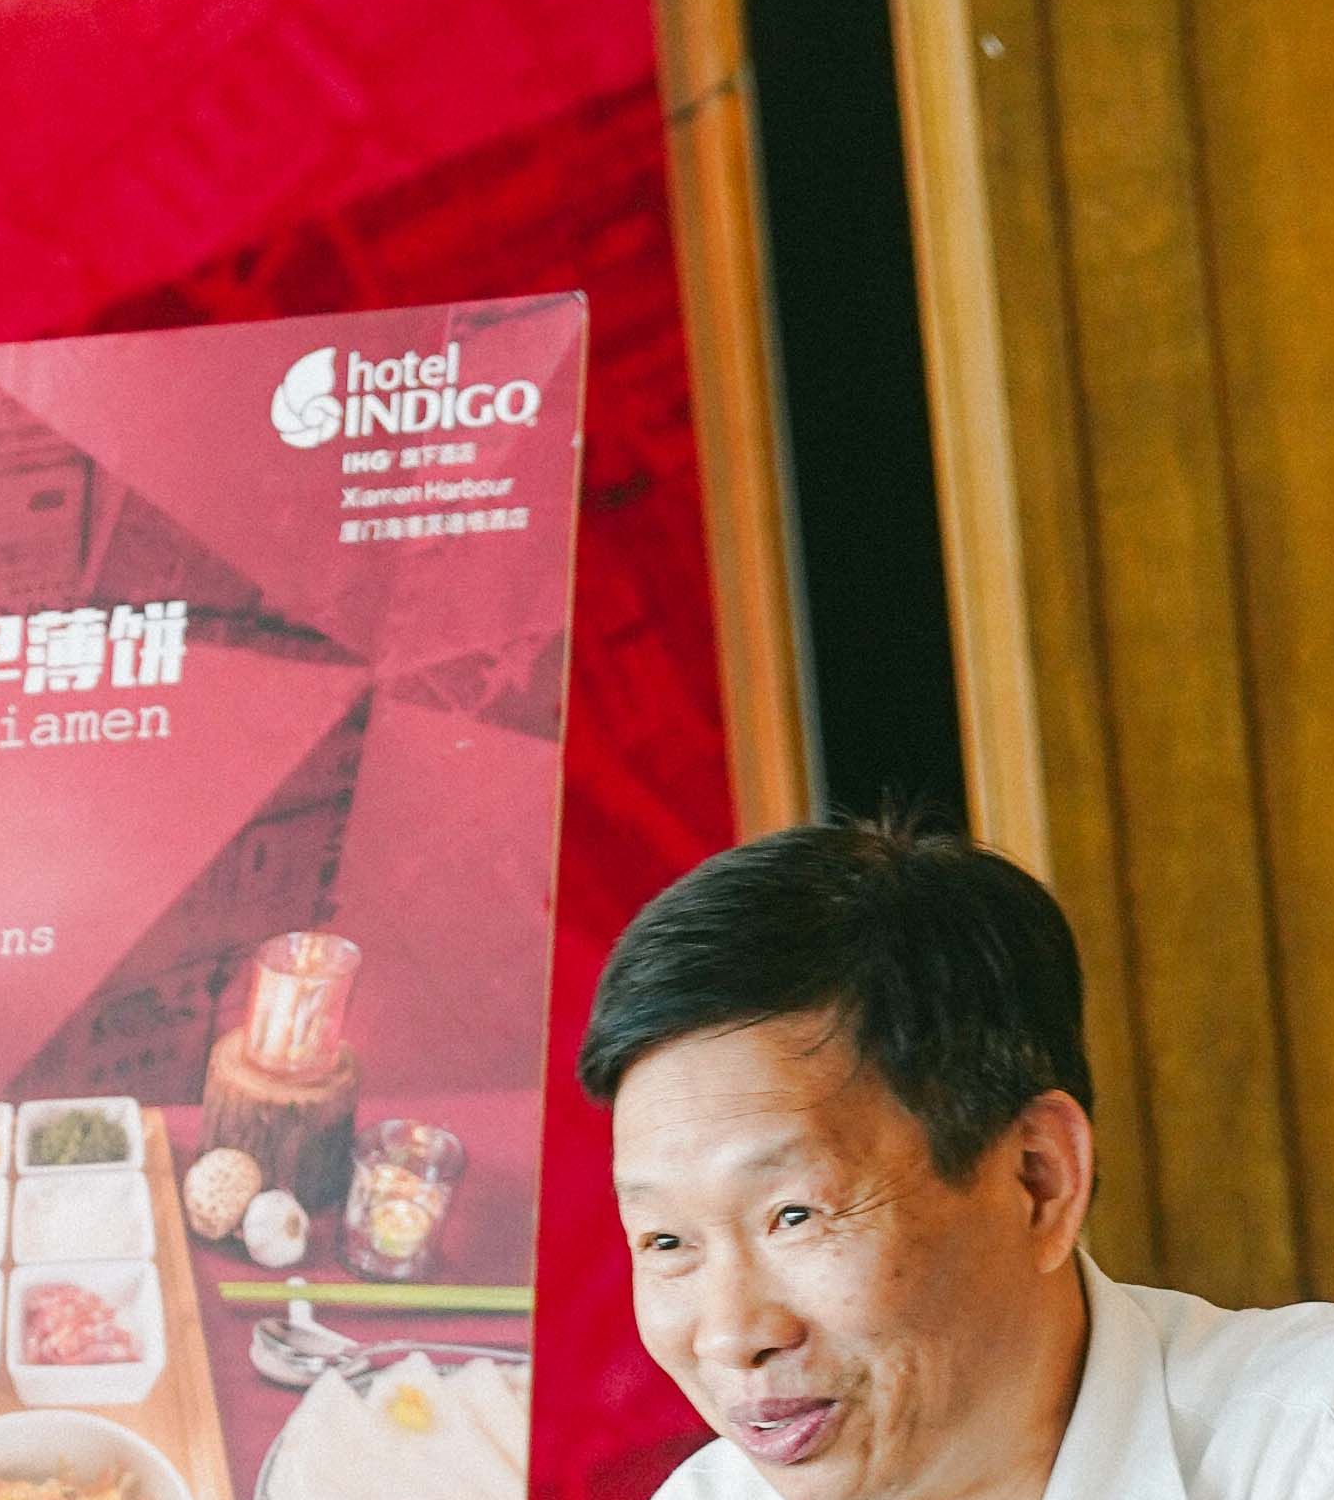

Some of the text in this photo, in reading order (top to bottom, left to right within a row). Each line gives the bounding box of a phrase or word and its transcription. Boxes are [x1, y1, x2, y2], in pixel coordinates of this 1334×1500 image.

[347, 341, 459, 392] hotel
[343, 379, 541, 438] INDIGO
[342, 451, 391, 473] IHG
